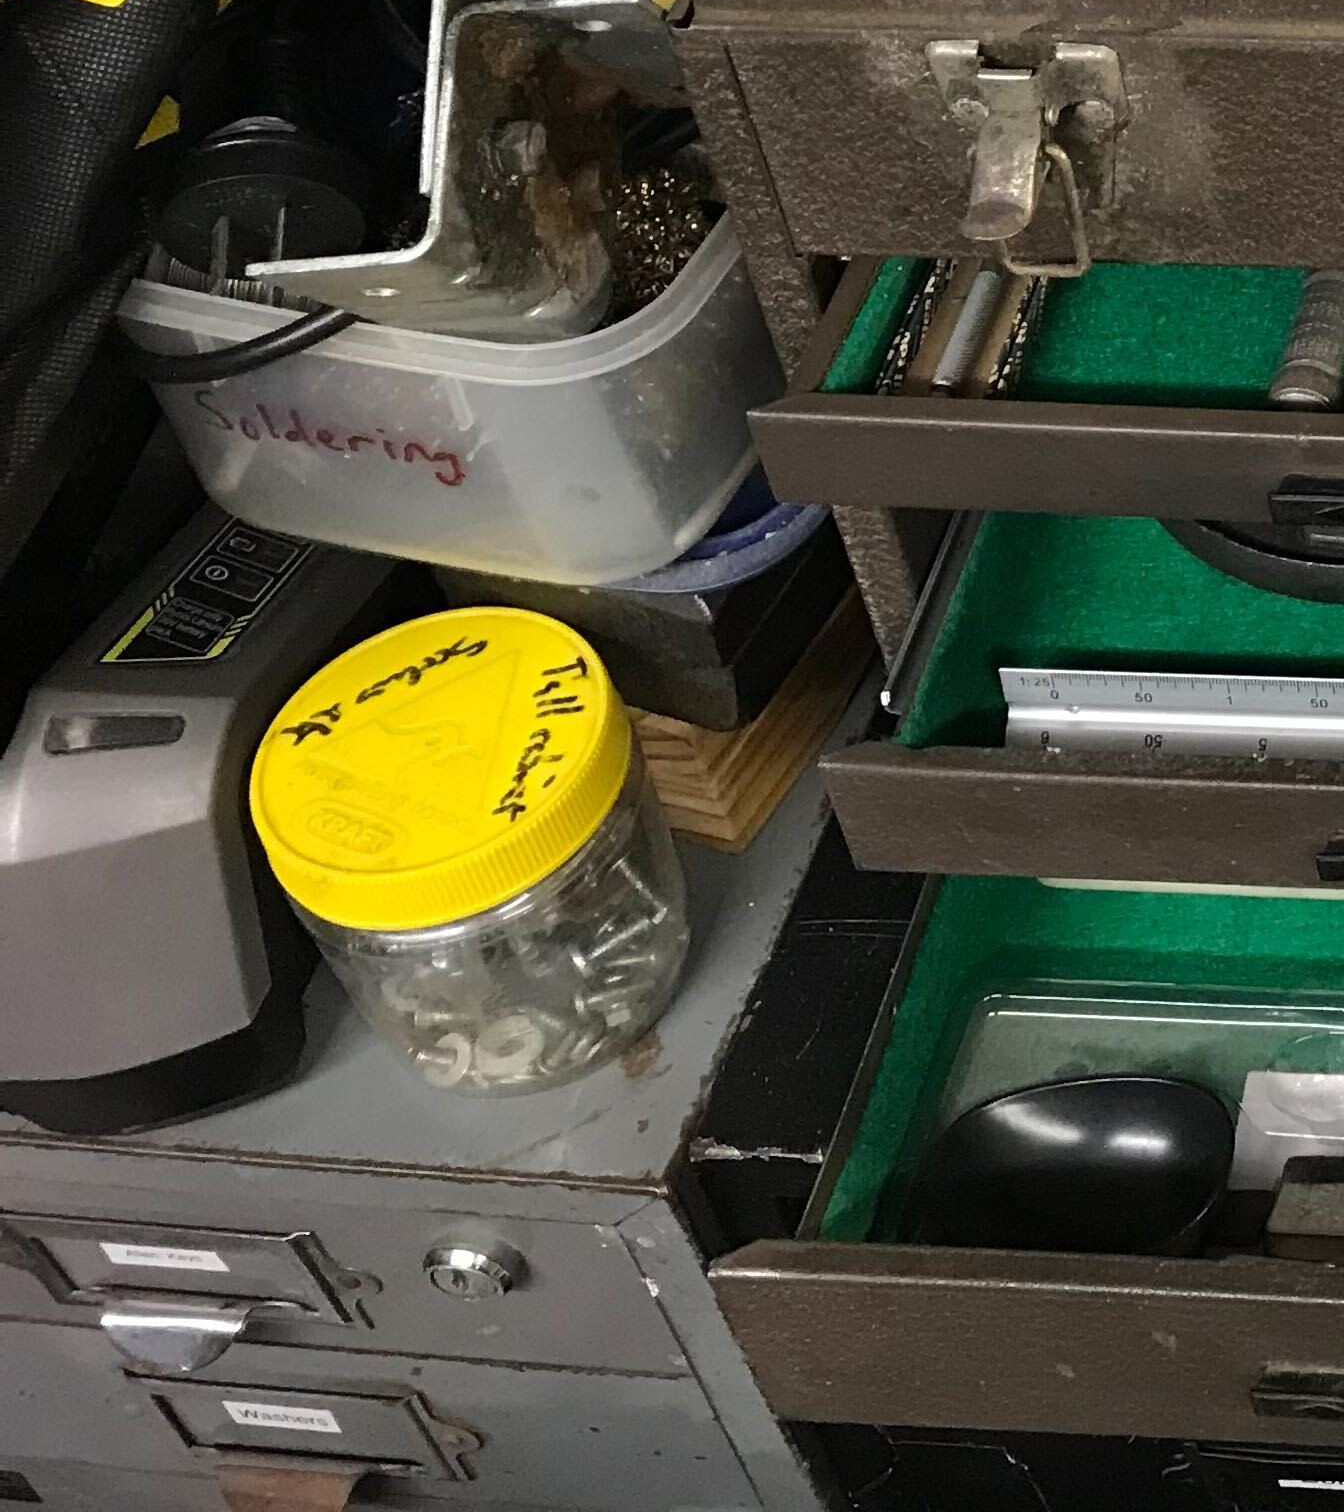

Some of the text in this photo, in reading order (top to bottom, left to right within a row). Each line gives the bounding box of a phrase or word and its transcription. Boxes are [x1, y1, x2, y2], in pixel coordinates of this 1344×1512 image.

[194, 390, 469, 487] Soldering
[1050, 690, 1059, 700] 0
[1135, 693, 1153, 703] 50
[1226, 695, 1232, 705] 1
[1310, 698, 1328, 709] 50
[1041, 731, 1050, 744] 6
[1144, 735, 1163, 748] 50
[1258, 738, 1267, 752] 5
[236, 1408, 330, 1429] Washers
